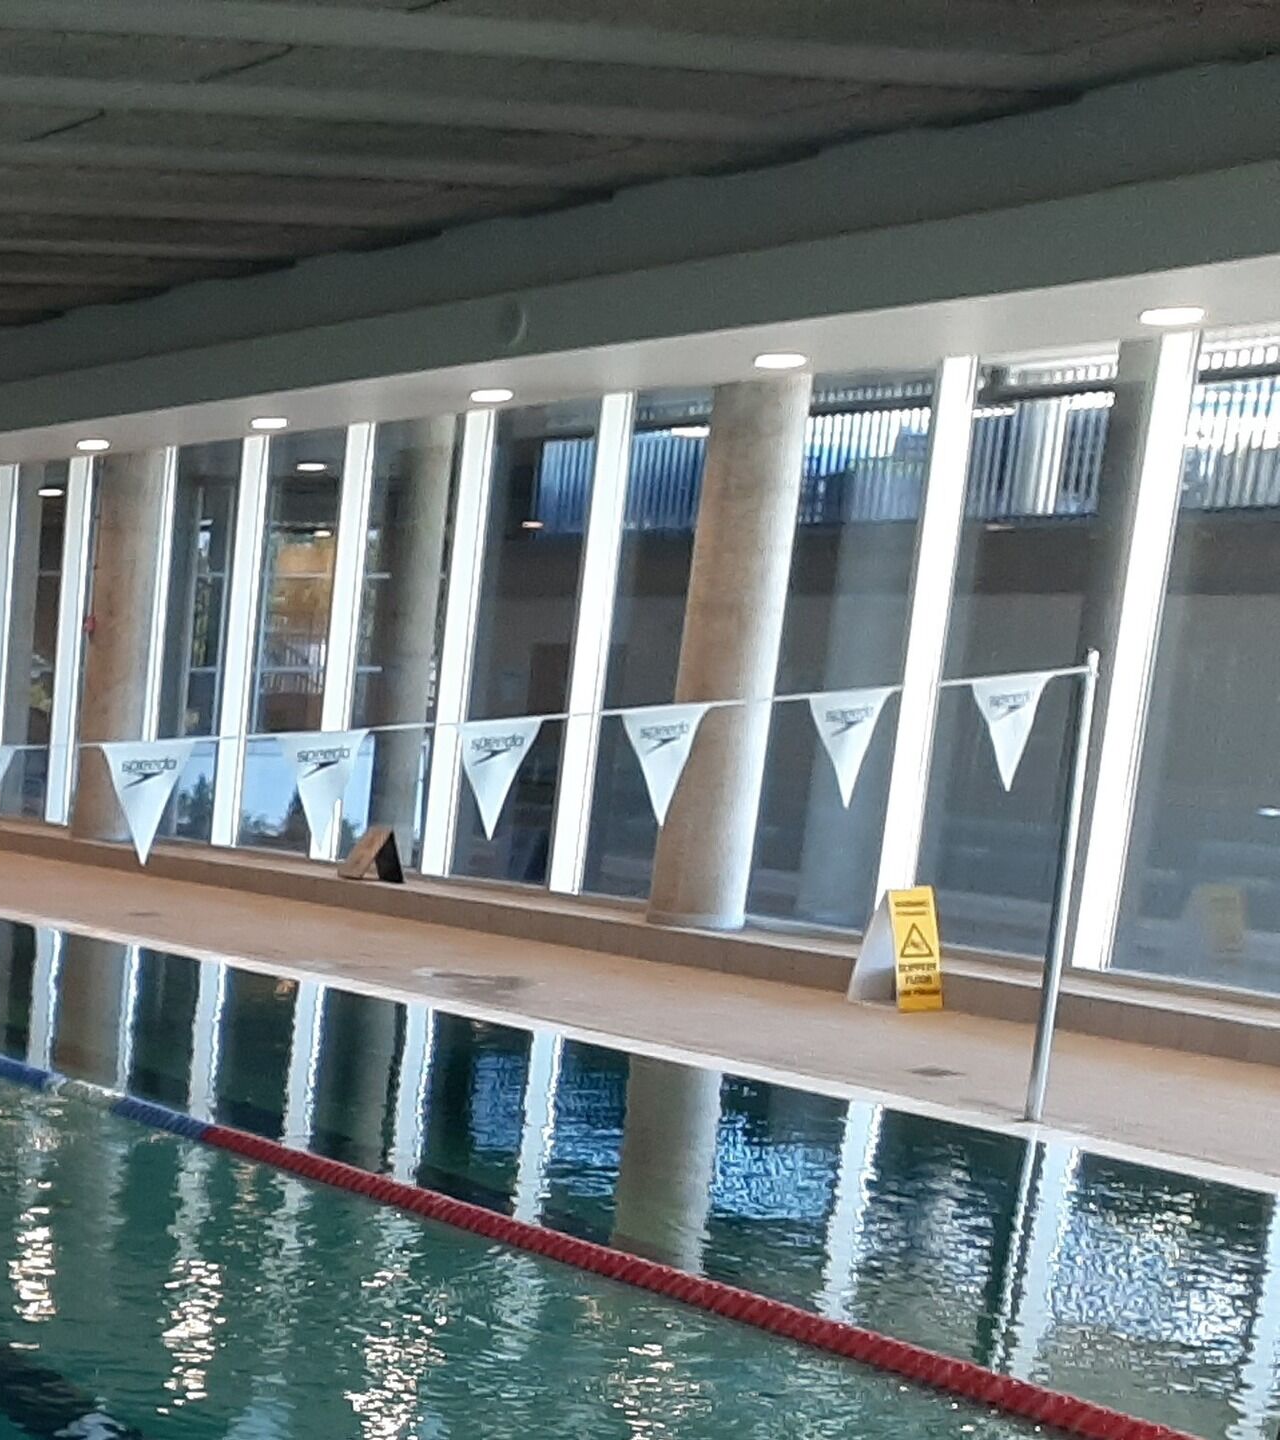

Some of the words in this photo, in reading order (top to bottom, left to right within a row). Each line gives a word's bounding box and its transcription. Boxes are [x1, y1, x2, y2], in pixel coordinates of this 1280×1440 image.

[471, 734, 525, 750] speedo
[296, 746, 351, 763] speedo
[122, 758, 177, 773] speedo
